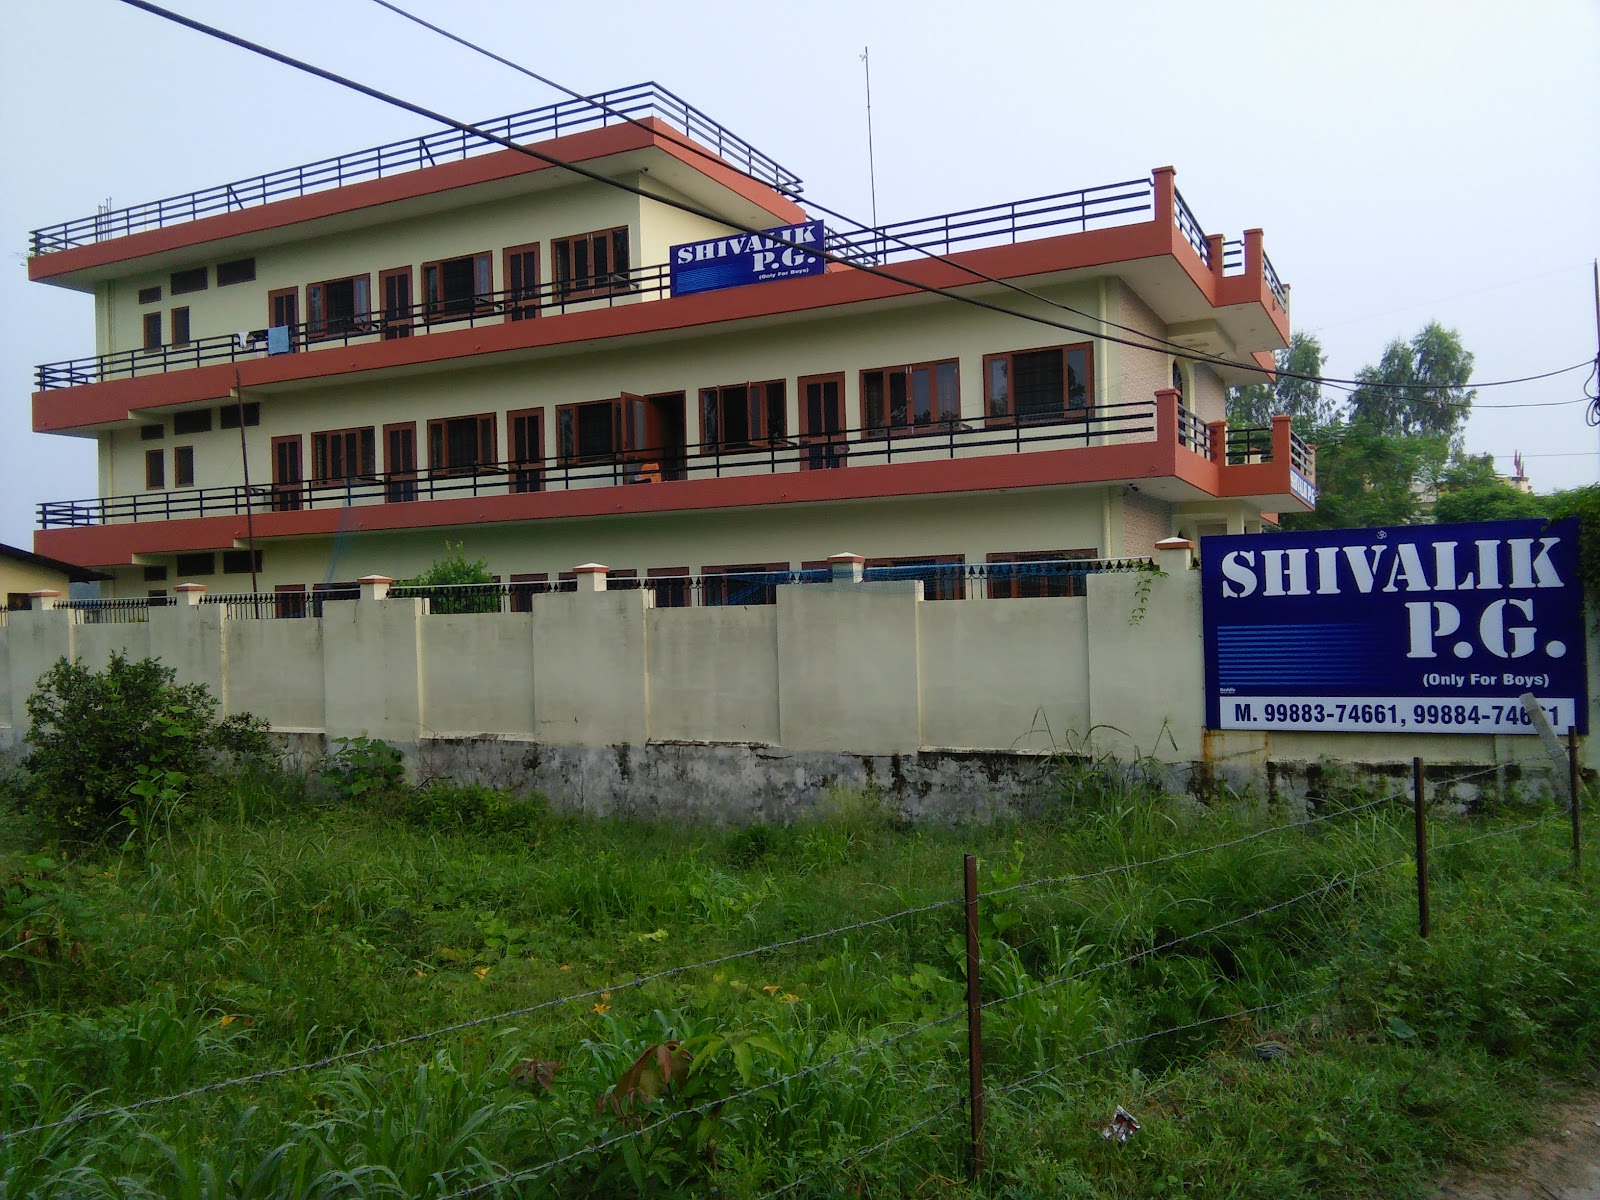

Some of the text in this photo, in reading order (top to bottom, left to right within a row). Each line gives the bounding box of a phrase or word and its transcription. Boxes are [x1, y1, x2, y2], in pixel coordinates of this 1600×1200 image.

[677, 226, 816, 265] SHIVALIK
[752, 247, 816, 272] P.G.
[758, 272, 776, 281] (Only
[790, 267, 809, 275] Boys)
[1221, 537, 1565, 598] SHIVALIK
[1404, 598, 1566, 659] P.G.
[1422, 673, 1550, 688] (Only For Boys)
[1234, 703, 1560, 728] M. 99883-74661, 99884-7461
